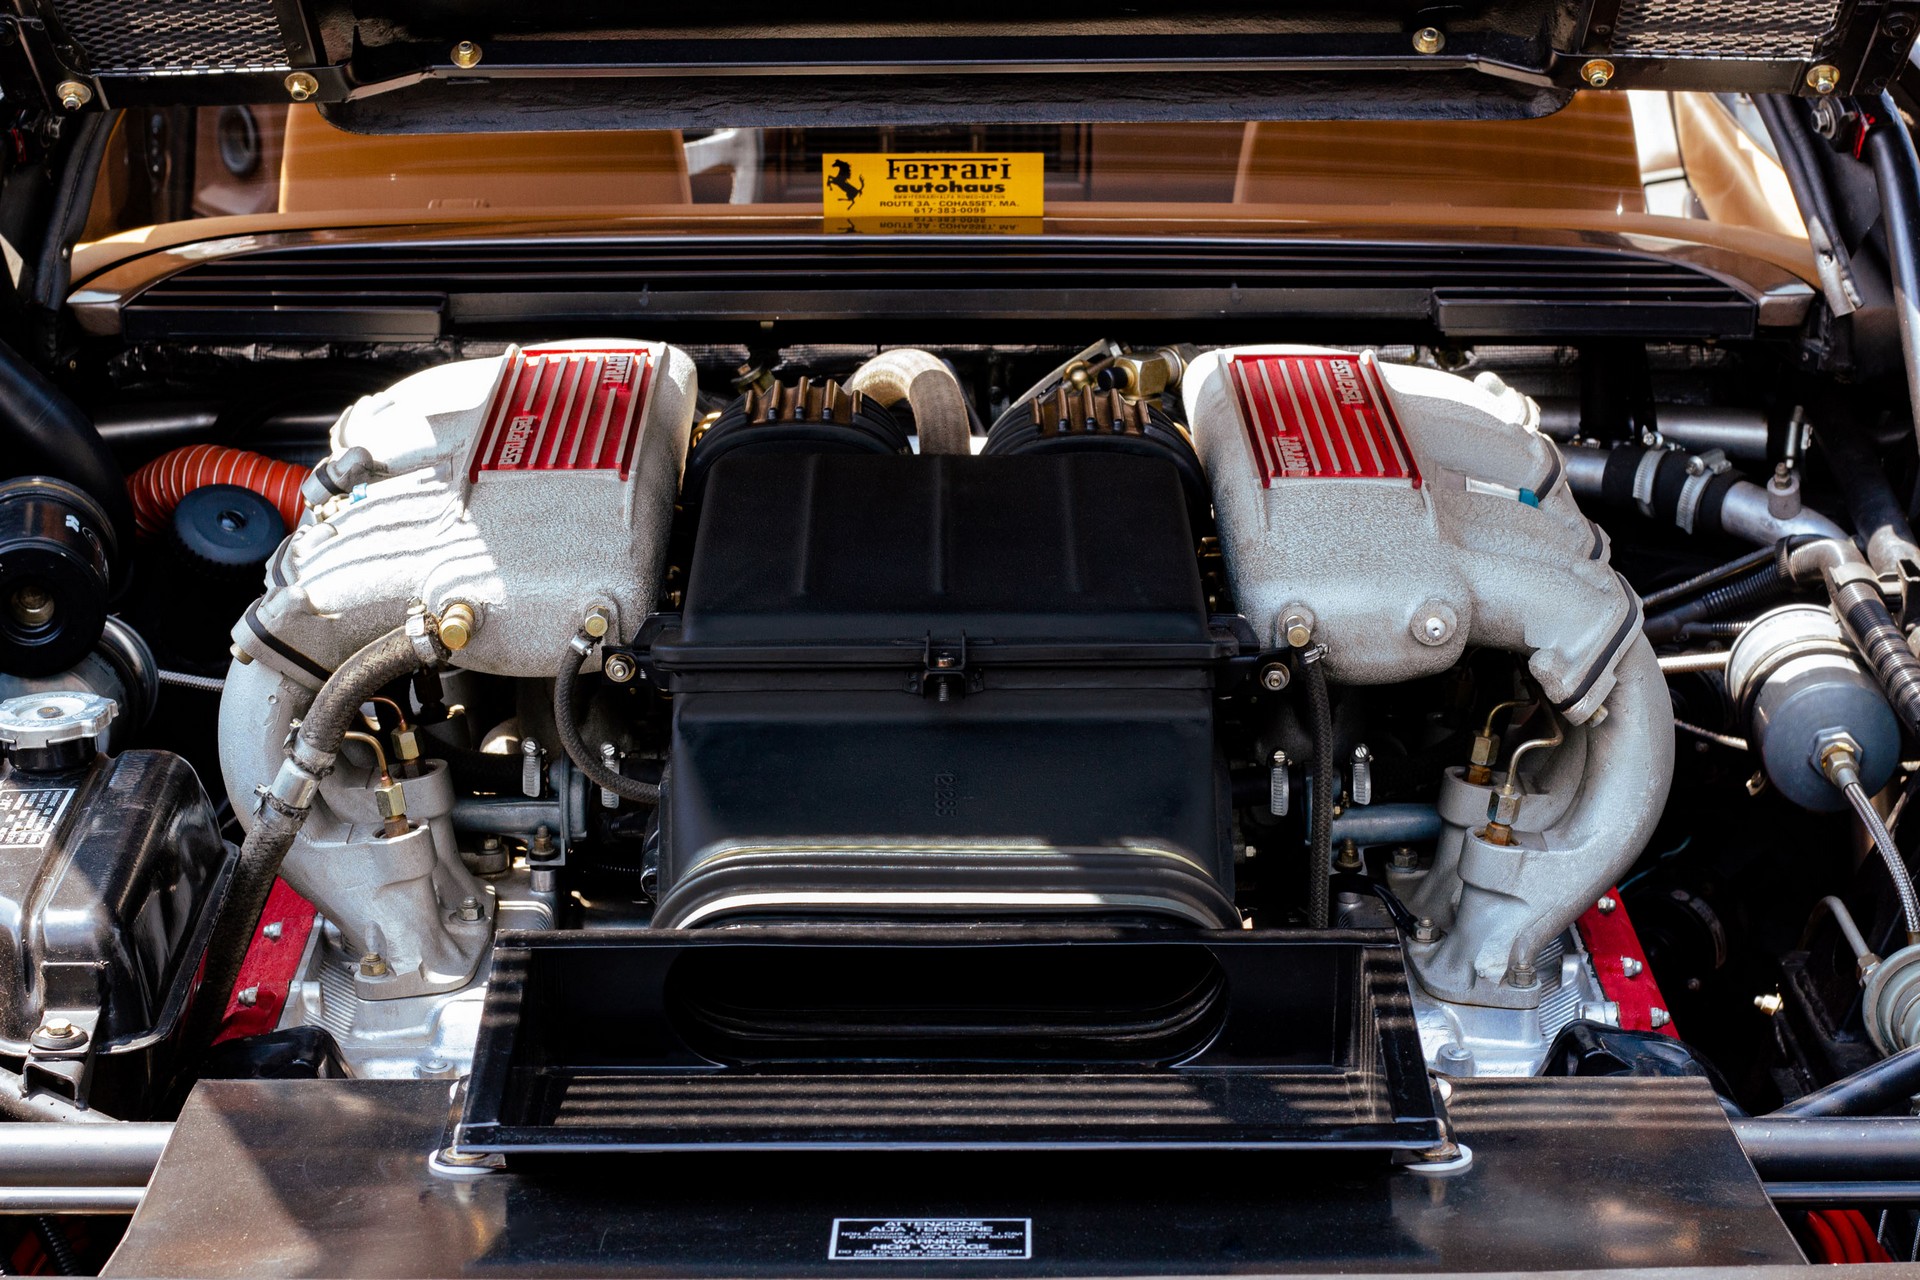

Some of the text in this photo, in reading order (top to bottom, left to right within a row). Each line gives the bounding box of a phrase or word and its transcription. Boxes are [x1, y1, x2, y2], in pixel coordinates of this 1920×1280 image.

[886, 158, 1011, 180] Ferrari
[893, 181, 1006, 193] autohaus
[939, 200, 996, 208] COHASSET,
